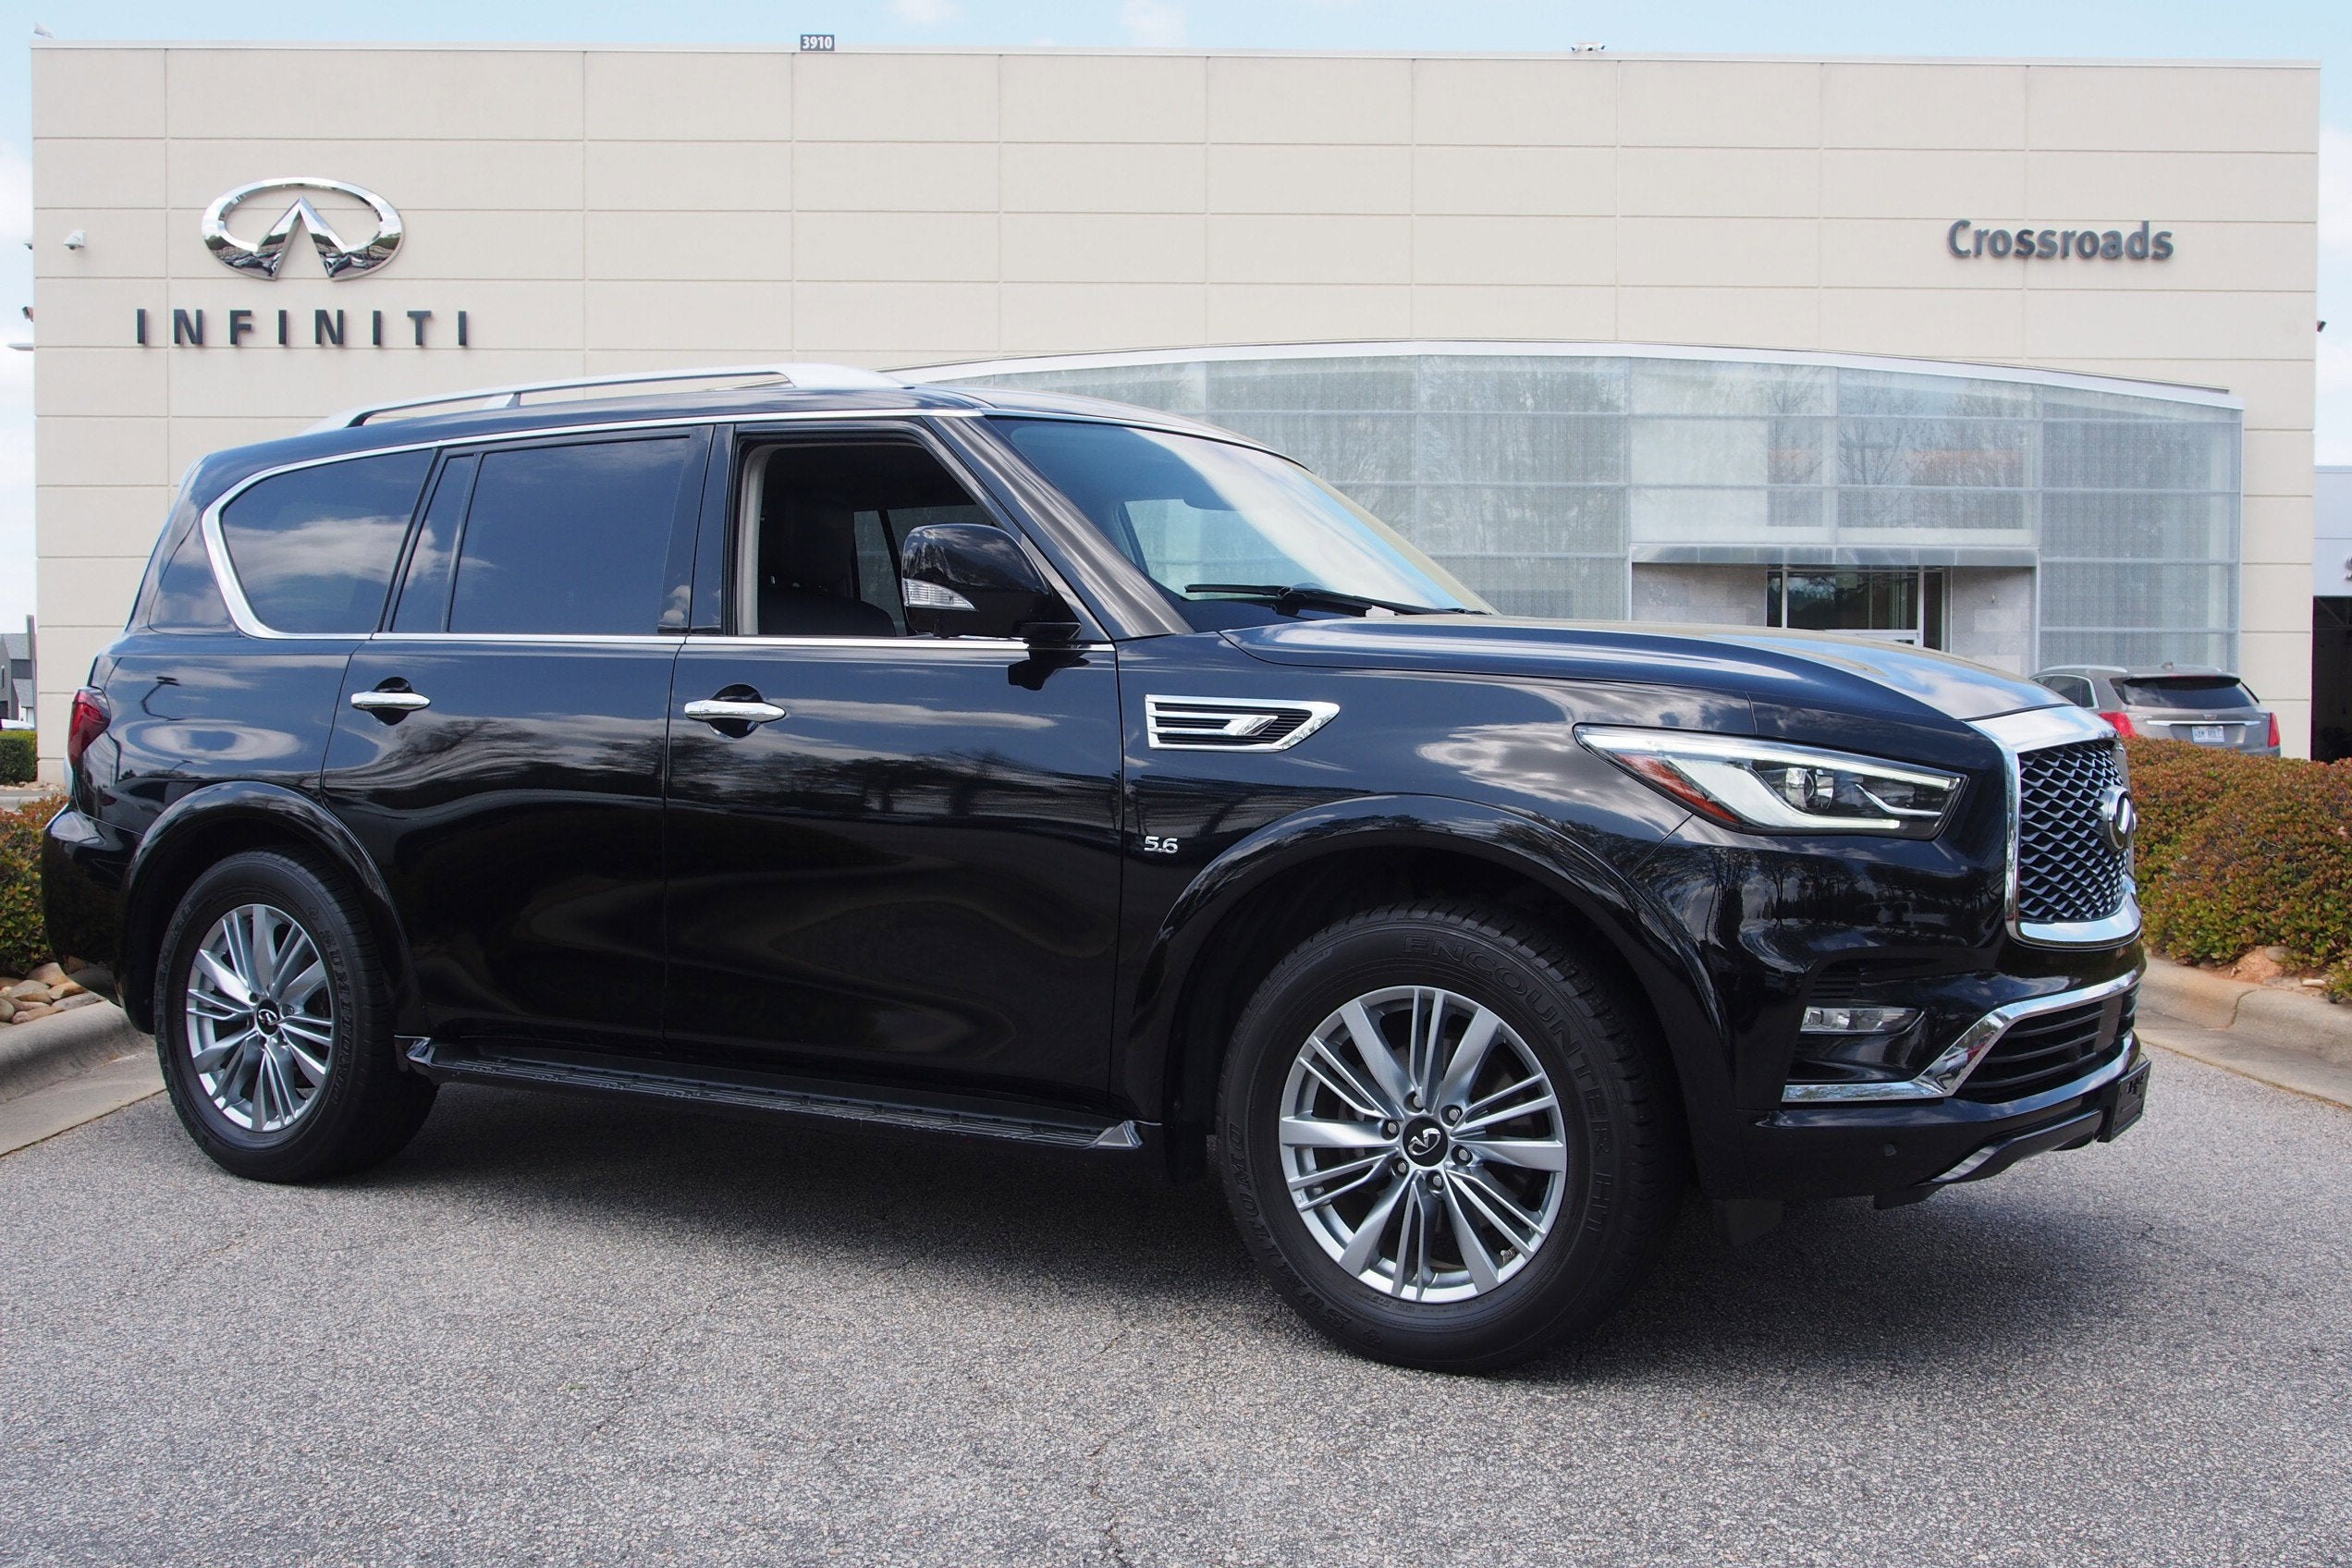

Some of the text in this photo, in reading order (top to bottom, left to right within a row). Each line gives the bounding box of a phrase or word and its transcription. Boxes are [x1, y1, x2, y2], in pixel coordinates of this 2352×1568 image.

[802, 35, 833, 50] 3910
[1948, 219, 2174, 259] Crossroads
[136, 308, 469, 346] INFINITI
[1144, 835, 1179, 854] 5.6
[1403, 934, 1613, 1157] ENCOUNTER
[1229, 1122, 1353, 1329] SUMITOMO
